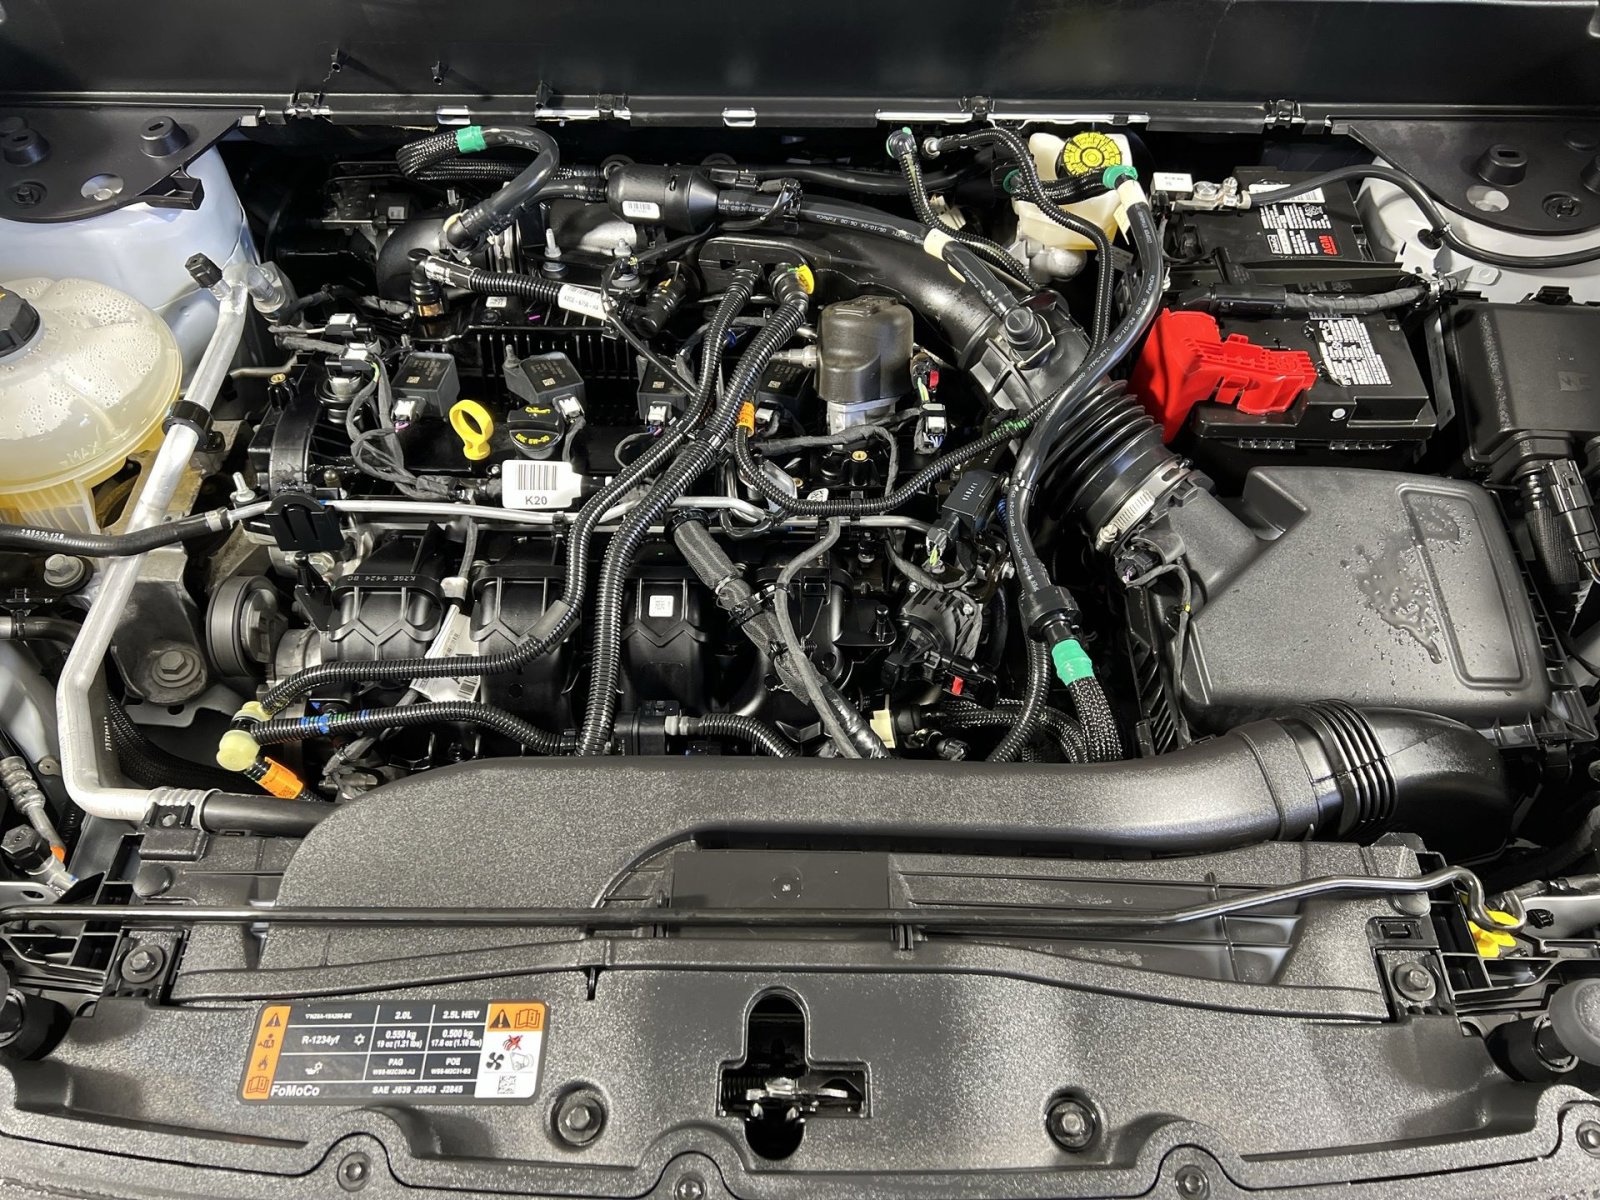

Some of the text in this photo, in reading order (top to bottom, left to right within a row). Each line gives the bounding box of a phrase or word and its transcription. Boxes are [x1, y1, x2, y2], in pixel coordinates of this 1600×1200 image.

[816, 214, 837, 222] FoMoCo
[1319, 235, 1334, 254] AGM
[1113, 316, 1136, 343] 05/10/24
[1146, 274, 1155, 295] FoMoCo
[525, 495, 547, 506] K20
[394, 1011, 413, 1020] 2.0L
[442, 1010, 480, 1019] 2.5L HEV
[385, 1030, 418, 1041] 0.550 kg
[442, 1029, 475, 1040] 0.500 kg
[301, 1034, 341, 1046] R-1234yf
[377, 1040, 385, 1048] 19
[388, 1058, 404, 1067] PAG
[446, 1057, 462, 1066] POE
[270, 1085, 320, 1097] FoMoCo
[372, 1086, 390, 1094] SAE
